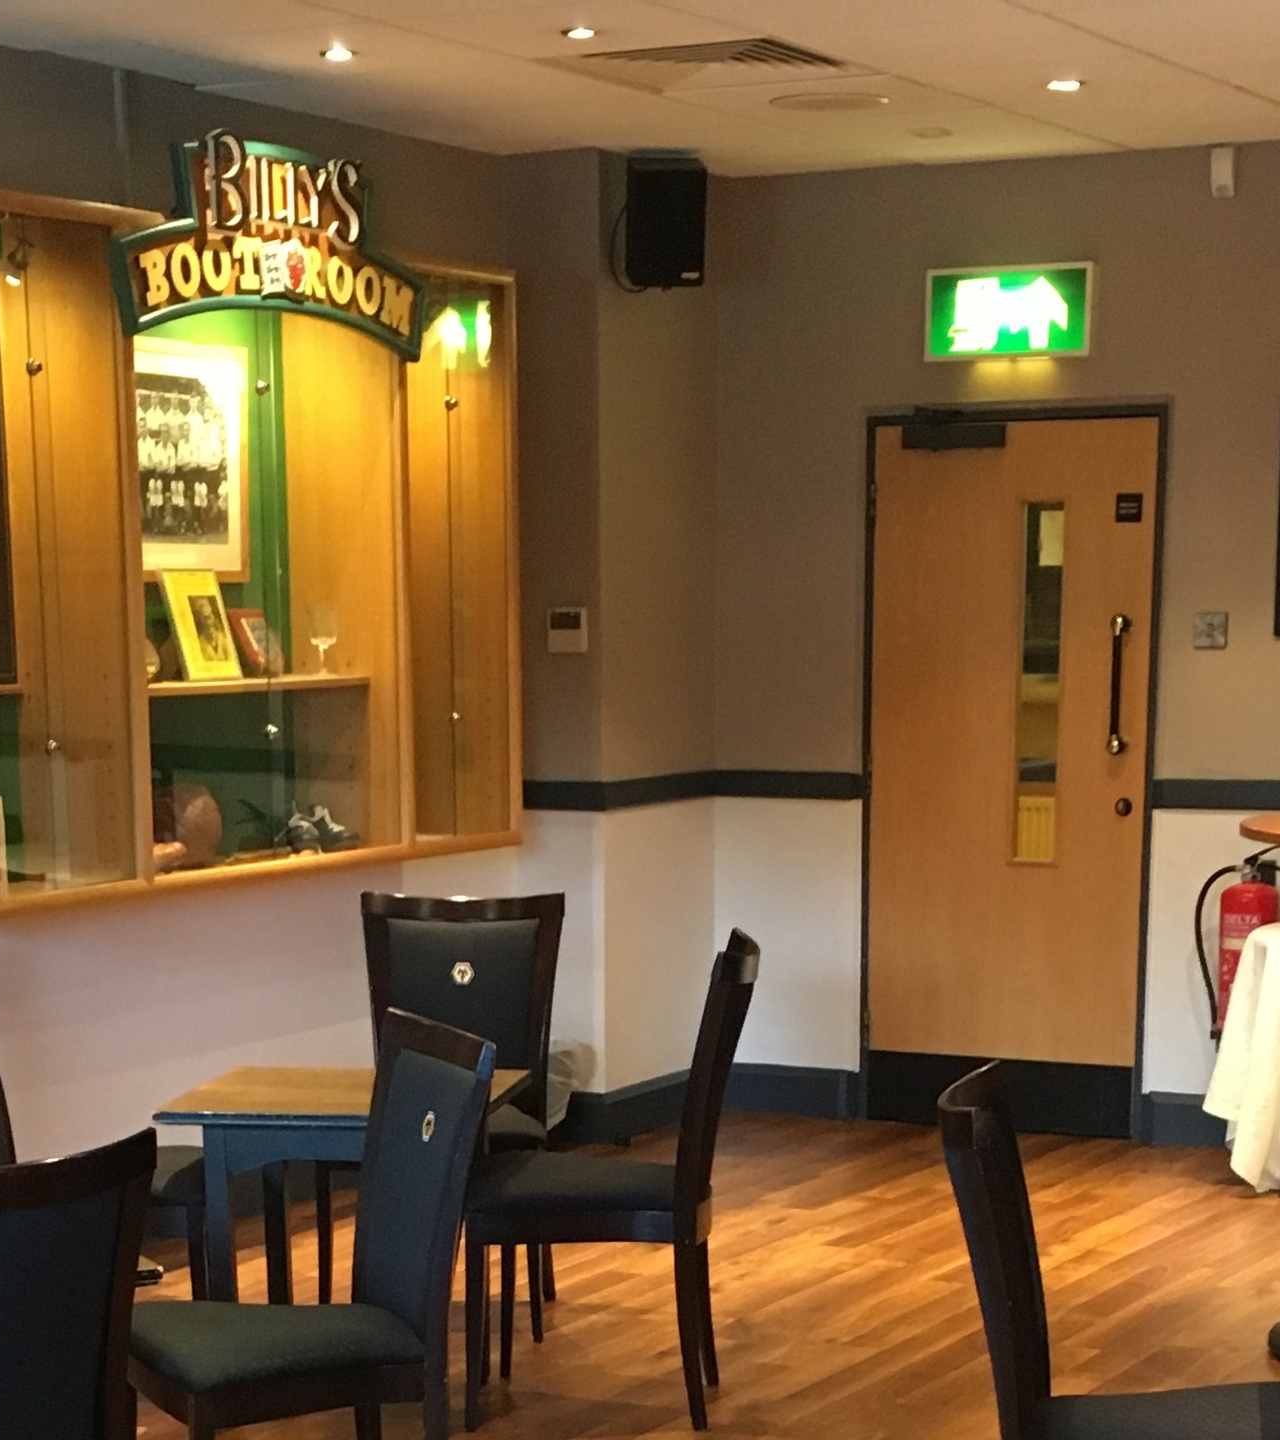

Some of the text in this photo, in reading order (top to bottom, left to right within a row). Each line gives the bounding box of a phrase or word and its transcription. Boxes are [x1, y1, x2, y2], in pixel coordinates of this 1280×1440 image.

[204, 127, 363, 250] BILLY'S
[138, 236, 415, 337] BOOT ROOM
